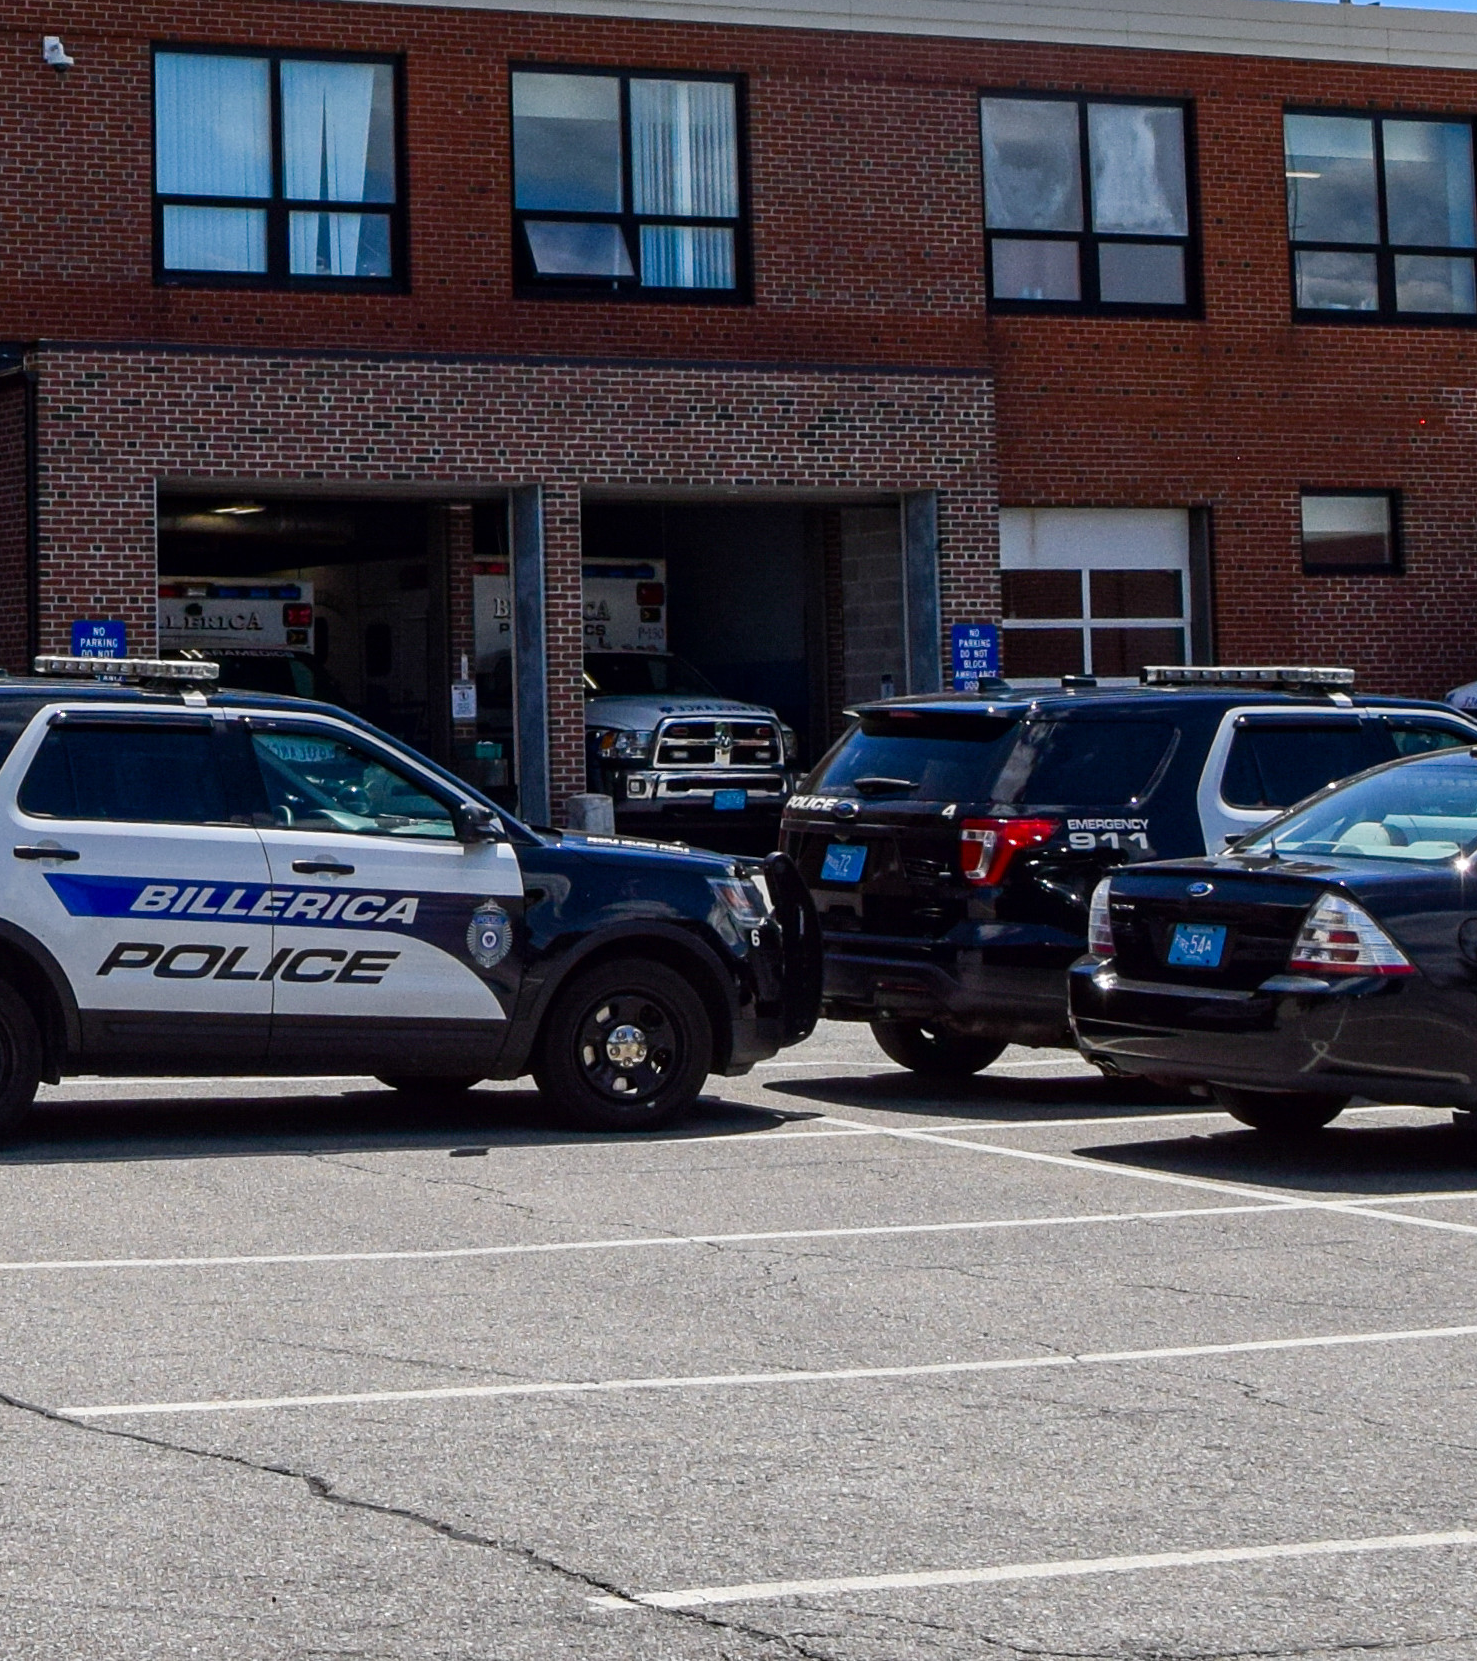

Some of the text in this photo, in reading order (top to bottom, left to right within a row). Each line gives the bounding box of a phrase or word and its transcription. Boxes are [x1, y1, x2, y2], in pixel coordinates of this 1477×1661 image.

[93, 626, 106, 636] NO
[80, 638, 119, 648] PARKING
[958, 638, 991, 648] PARKING
[97, 649, 115, 658] NOT
[200, 649, 295, 658] ARAMEDICS
[973, 649, 988, 658] NOT
[963, 659, 988, 669] BLOCK
[786, 795, 838, 811] POLICE
[942, 804, 957, 819] 4
[1067, 819, 1149, 830] EMERGENCY
[1068, 832, 1148, 850] 911
[130, 885, 420, 924] BILLERICA
[751, 929, 761, 947] 6
[96, 942, 401, 984] POLICE
